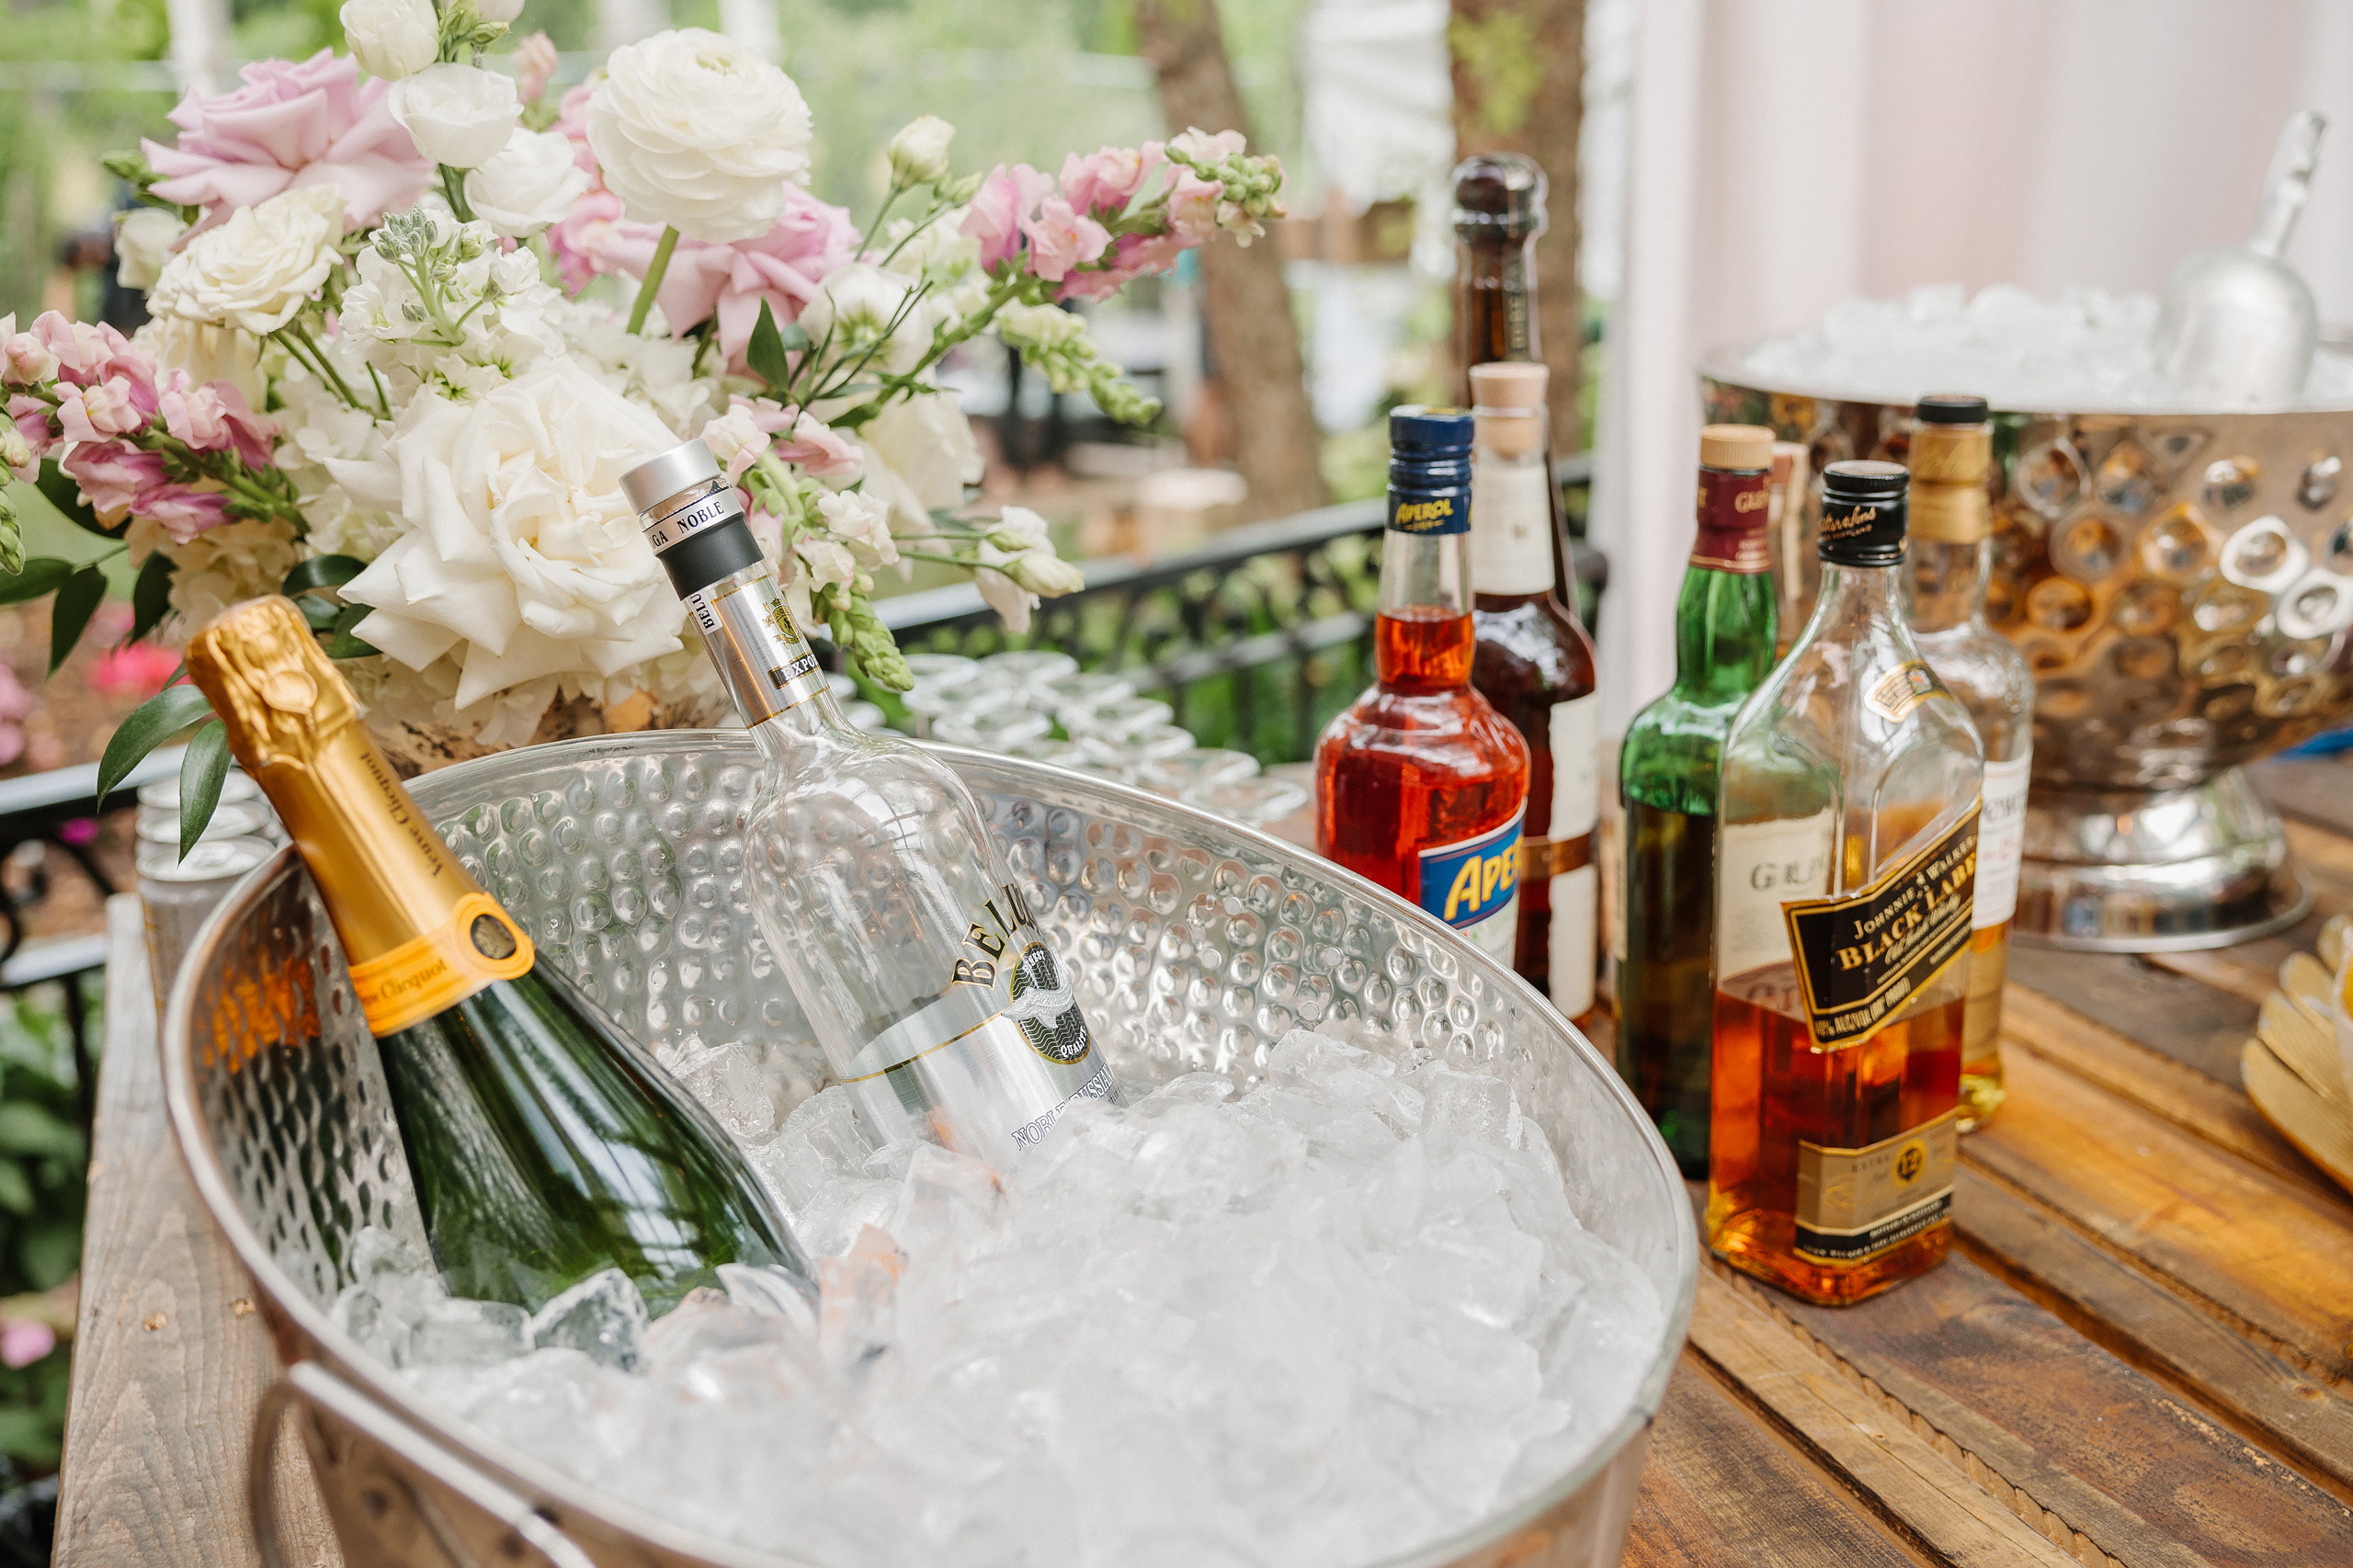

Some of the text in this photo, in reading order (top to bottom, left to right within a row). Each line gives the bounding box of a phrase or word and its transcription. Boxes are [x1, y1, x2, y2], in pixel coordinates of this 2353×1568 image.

[676, 501, 724, 534] NOBLE
[1395, 498, 1454, 525] APEROL
[690, 593, 716, 630] BELU
[360, 752, 443, 877] Veuve Clicquot
[1836, 902, 1924, 971] BLACK
[1061, 1026, 1086, 1058] QUALITY
